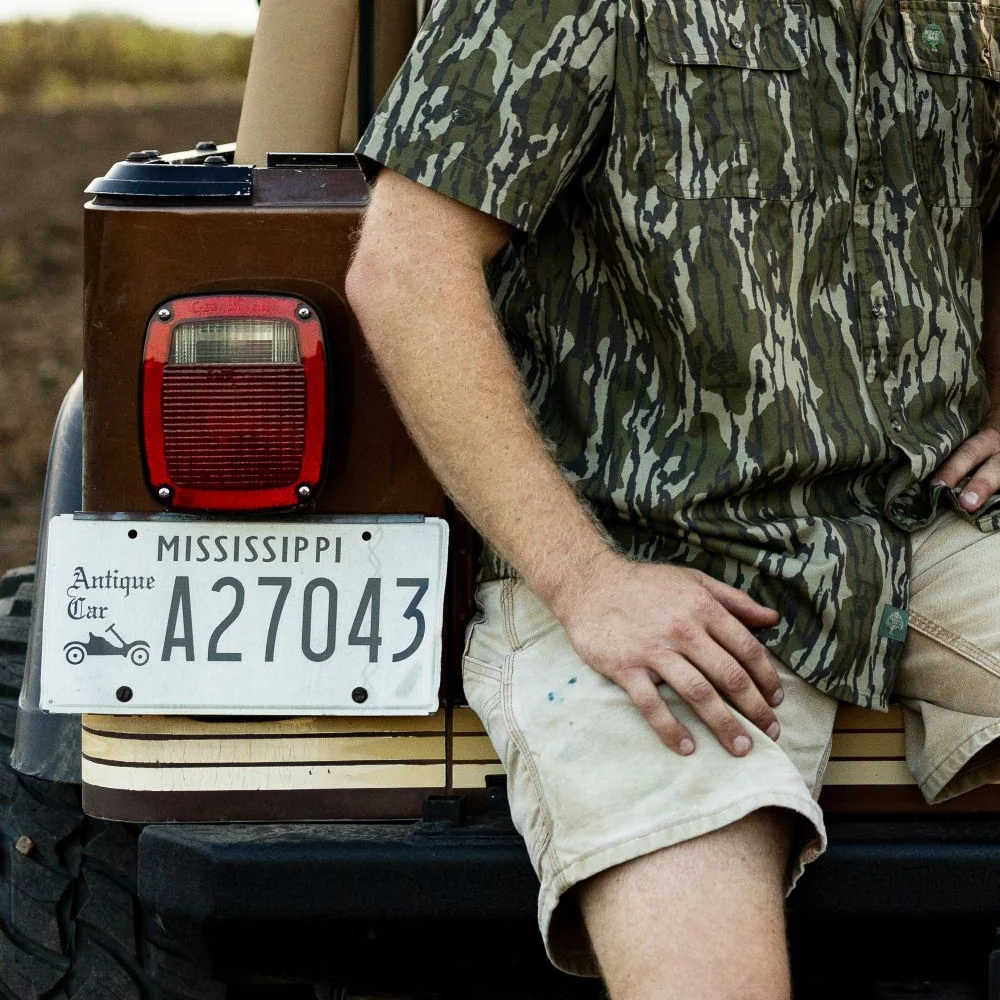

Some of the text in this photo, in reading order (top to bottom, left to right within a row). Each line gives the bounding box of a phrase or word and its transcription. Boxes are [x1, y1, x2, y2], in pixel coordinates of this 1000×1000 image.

[157, 535, 343, 563] MISSISSIPPI
[67, 566, 156, 598] Antique
[67, 596, 109, 620] Car
[161, 575, 430, 664] A27043
